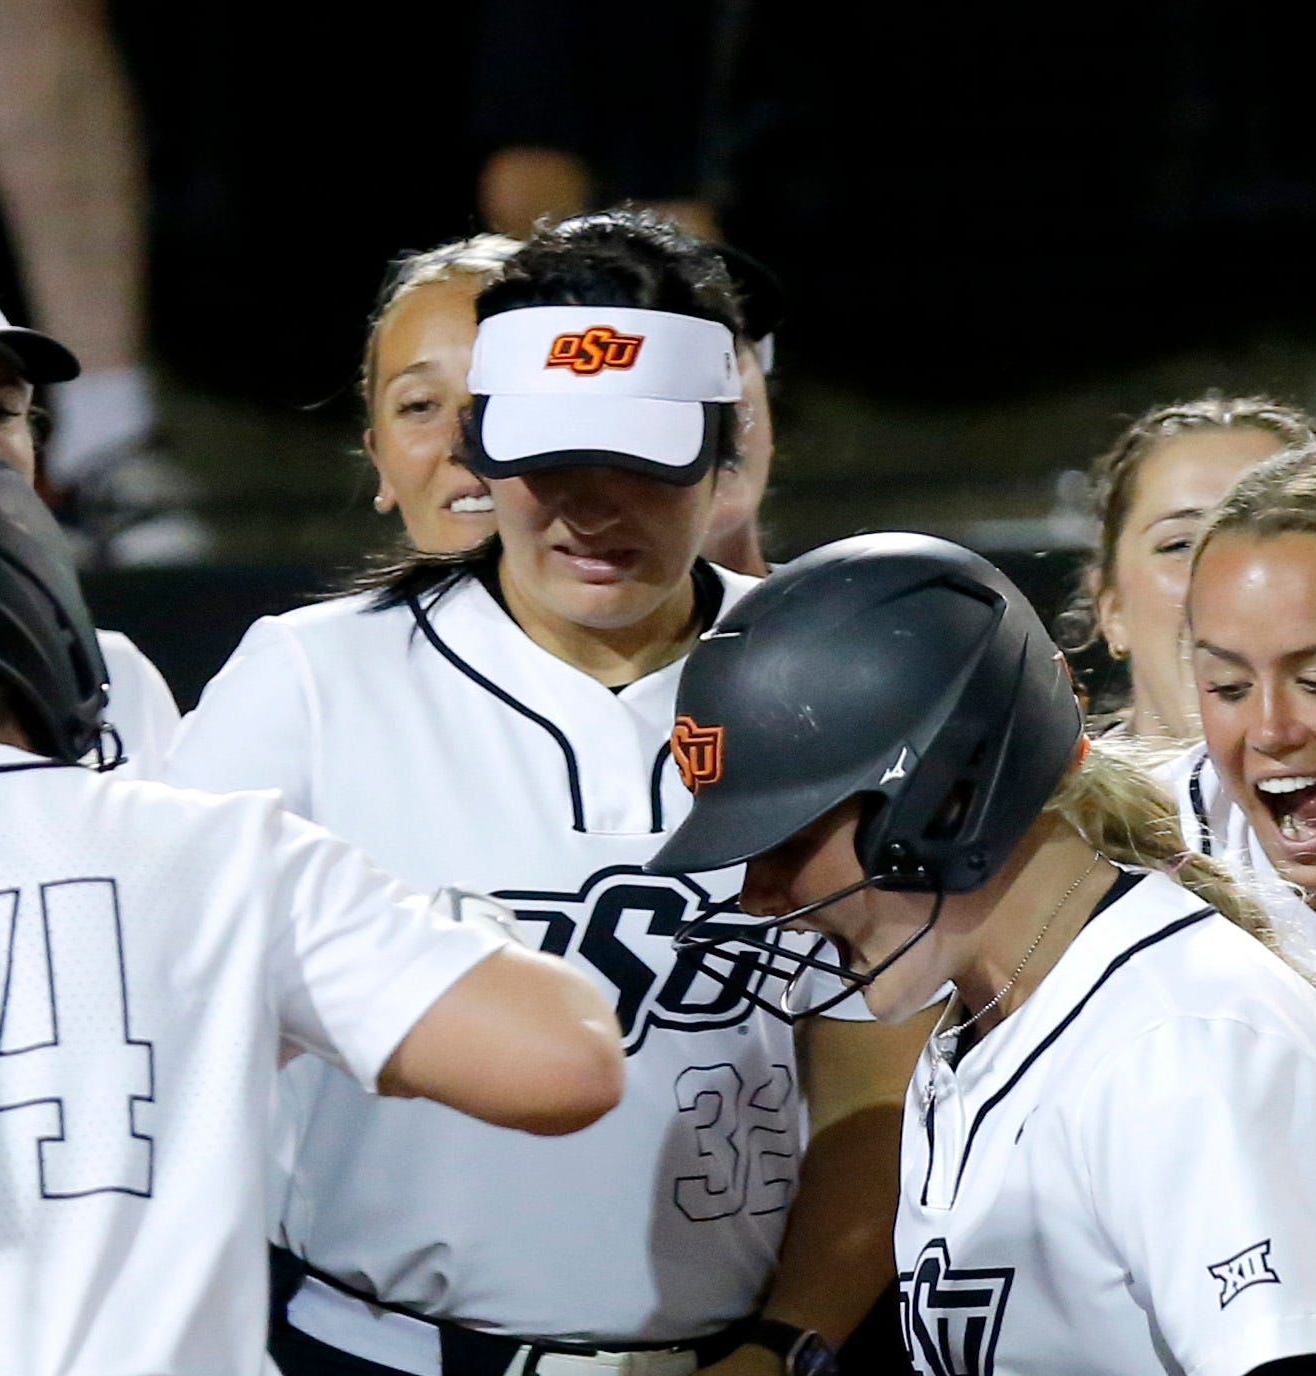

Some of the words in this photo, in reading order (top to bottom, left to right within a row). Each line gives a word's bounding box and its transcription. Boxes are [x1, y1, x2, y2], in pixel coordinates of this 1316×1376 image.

[544, 325, 645, 377] OSU
[670, 716, 725, 793] SU
[488, 864, 785, 1058] SU
